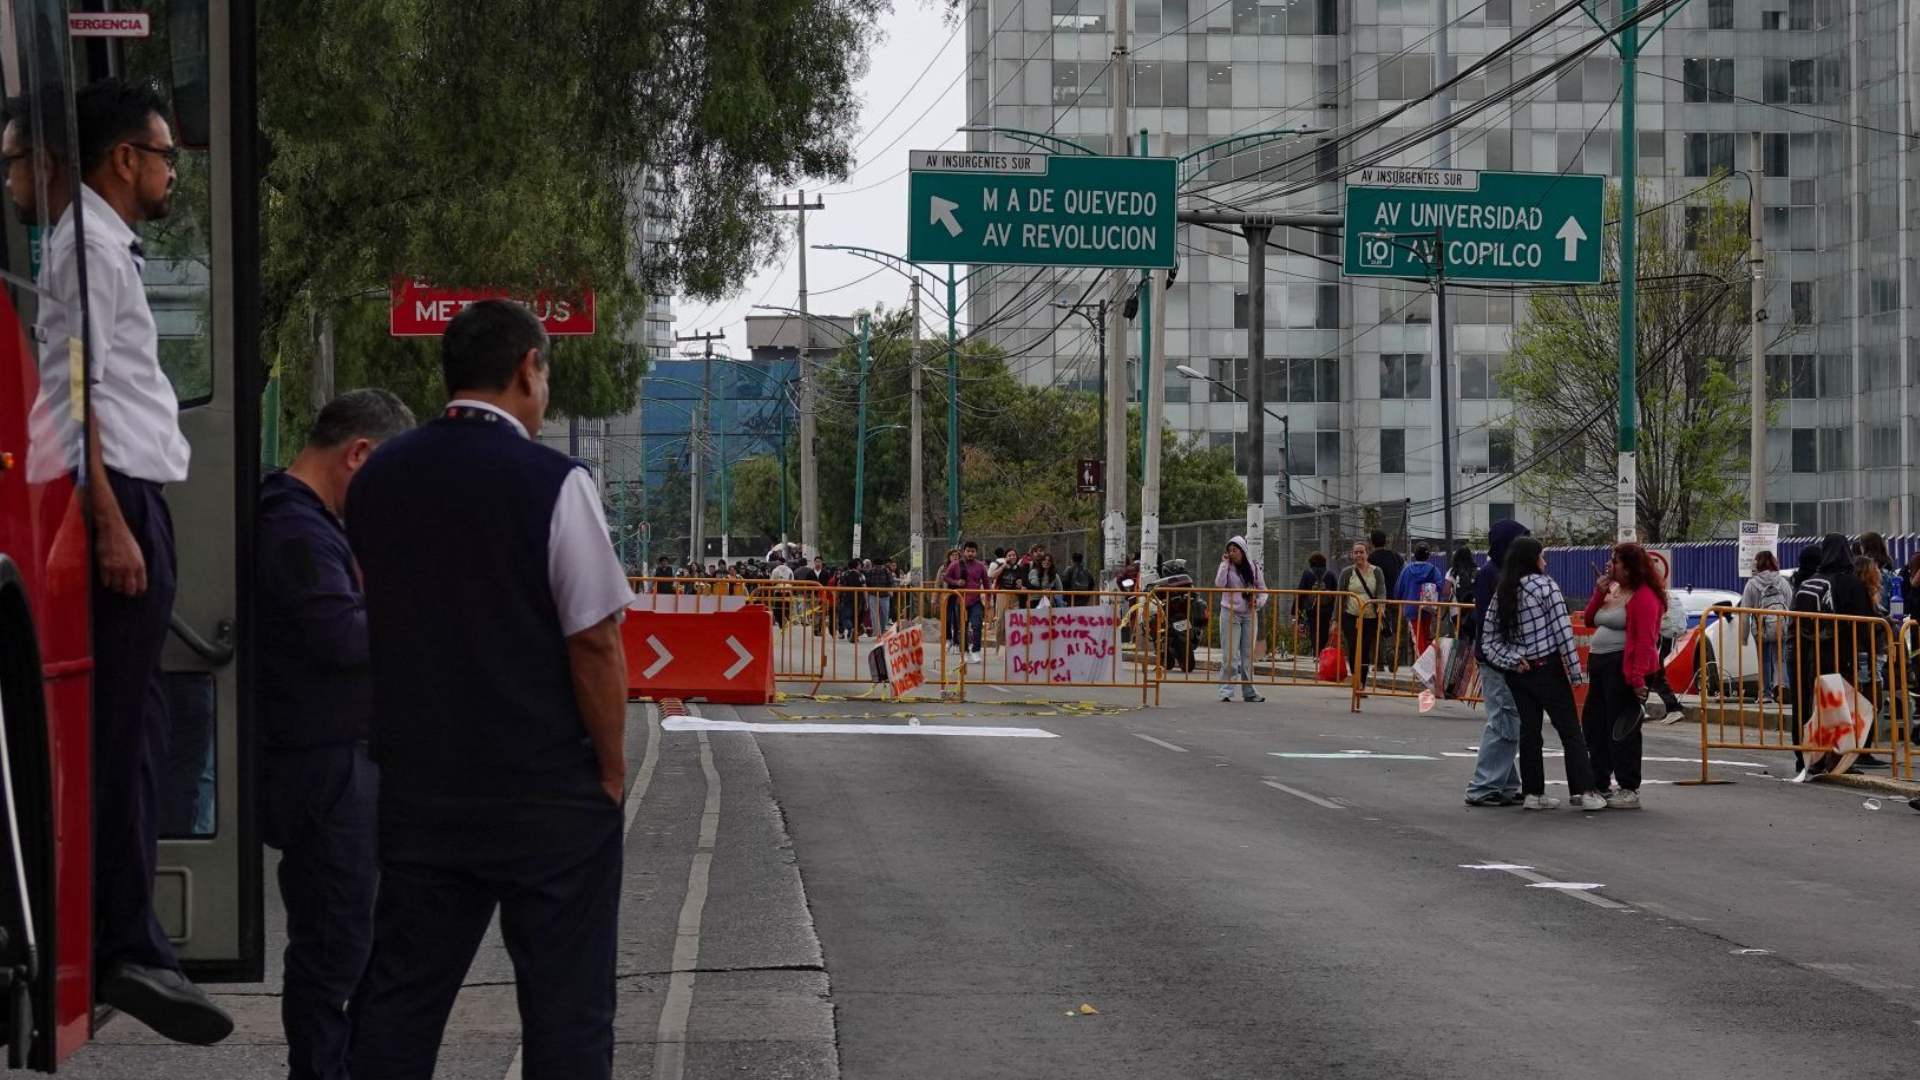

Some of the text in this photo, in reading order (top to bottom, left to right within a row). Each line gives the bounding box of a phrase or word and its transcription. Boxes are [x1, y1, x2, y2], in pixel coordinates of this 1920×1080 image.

[926, 155, 1031, 169] AV INSURGENTES SUR
[1361, 170, 1462, 185] AV INSURGENTES SUR
[983, 187, 1157, 217] M A DE QUEVEDO
[1374, 201, 1543, 231] AV UNIVERSIDAD
[982, 223, 1156, 250] AV REVOLUCION
[1365, 240, 1389, 262] 10
[1448, 240, 1542, 267] COPILCO
[415, 300, 571, 322] METUS
